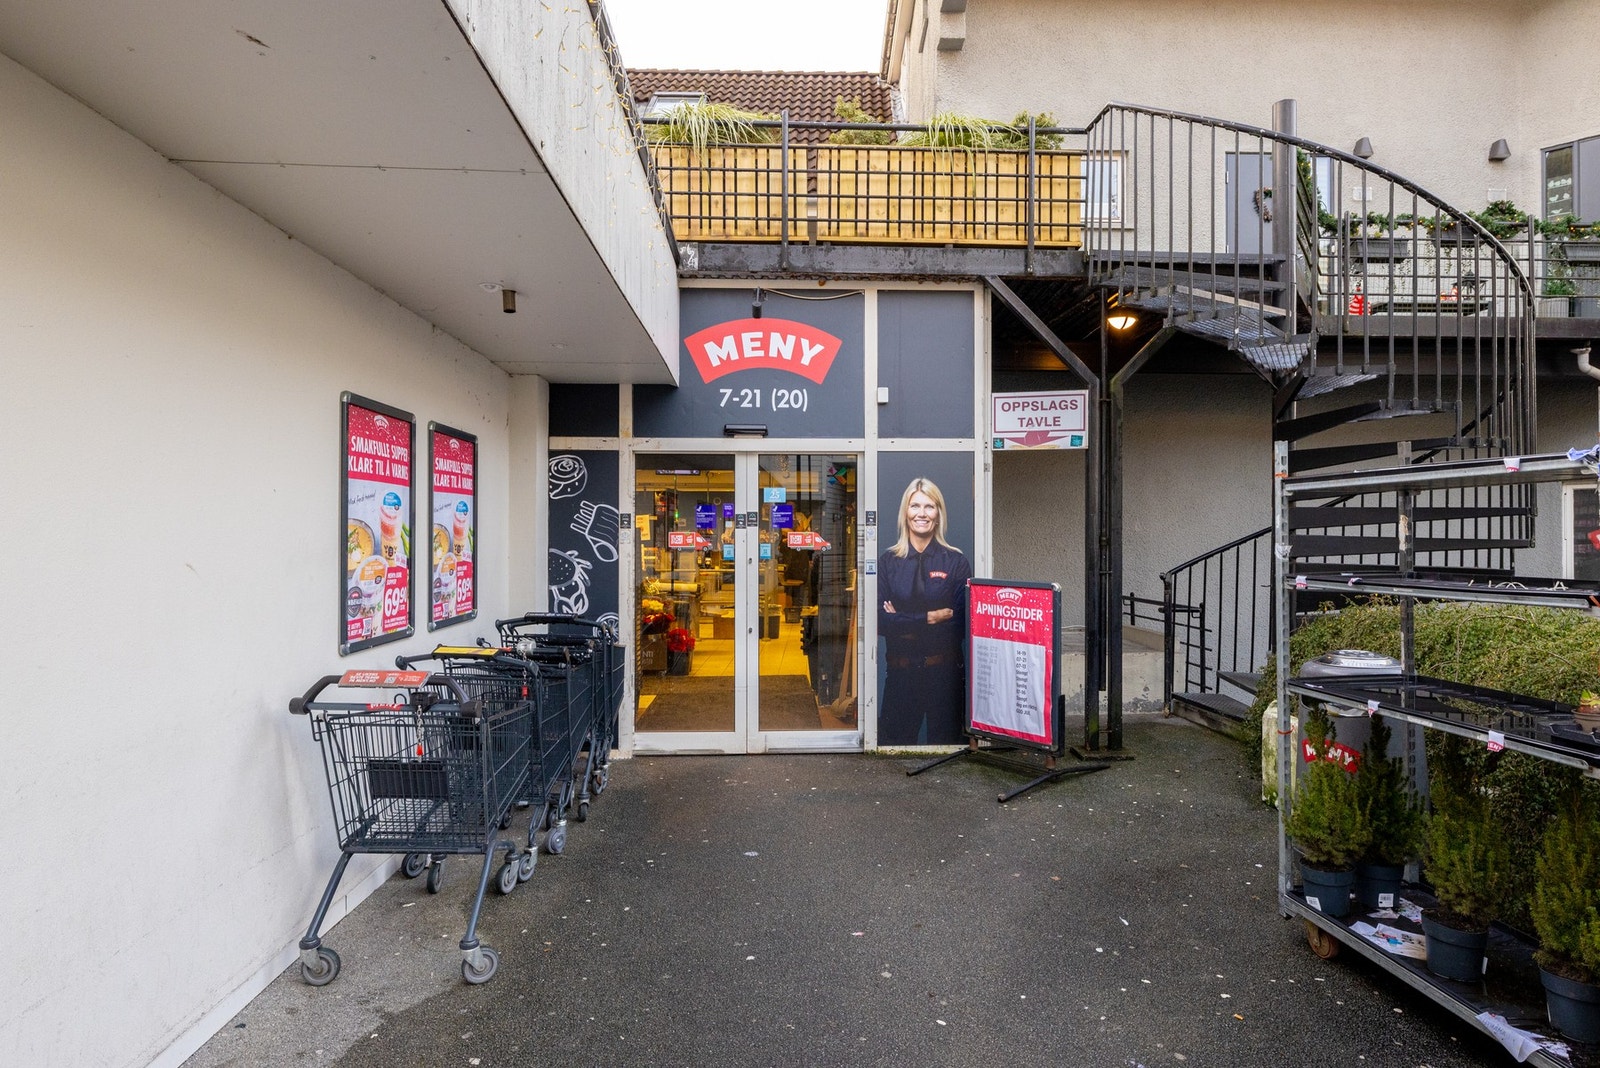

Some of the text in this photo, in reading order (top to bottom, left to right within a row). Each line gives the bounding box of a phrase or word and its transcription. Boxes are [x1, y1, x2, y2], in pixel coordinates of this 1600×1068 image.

[704, 331, 825, 367] MENY
[719, 388, 808, 412] 7-21 (20)
[1001, 399, 1078, 412] OPPSLAGS
[1018, 416, 1061, 427] TAVLE
[351, 435, 390, 458] SMAKFULLE
[348, 455, 373, 474] KLARE
[375, 459, 384, 475] TIL
[385, 460, 390, 477] Å
[999, 592, 1020, 601] MENY
[976, 601, 1043, 621] ÅPNINGSTIDER
[992, 617, 1026, 632] I JULEN
[1305, 744, 1353, 765] MNY
